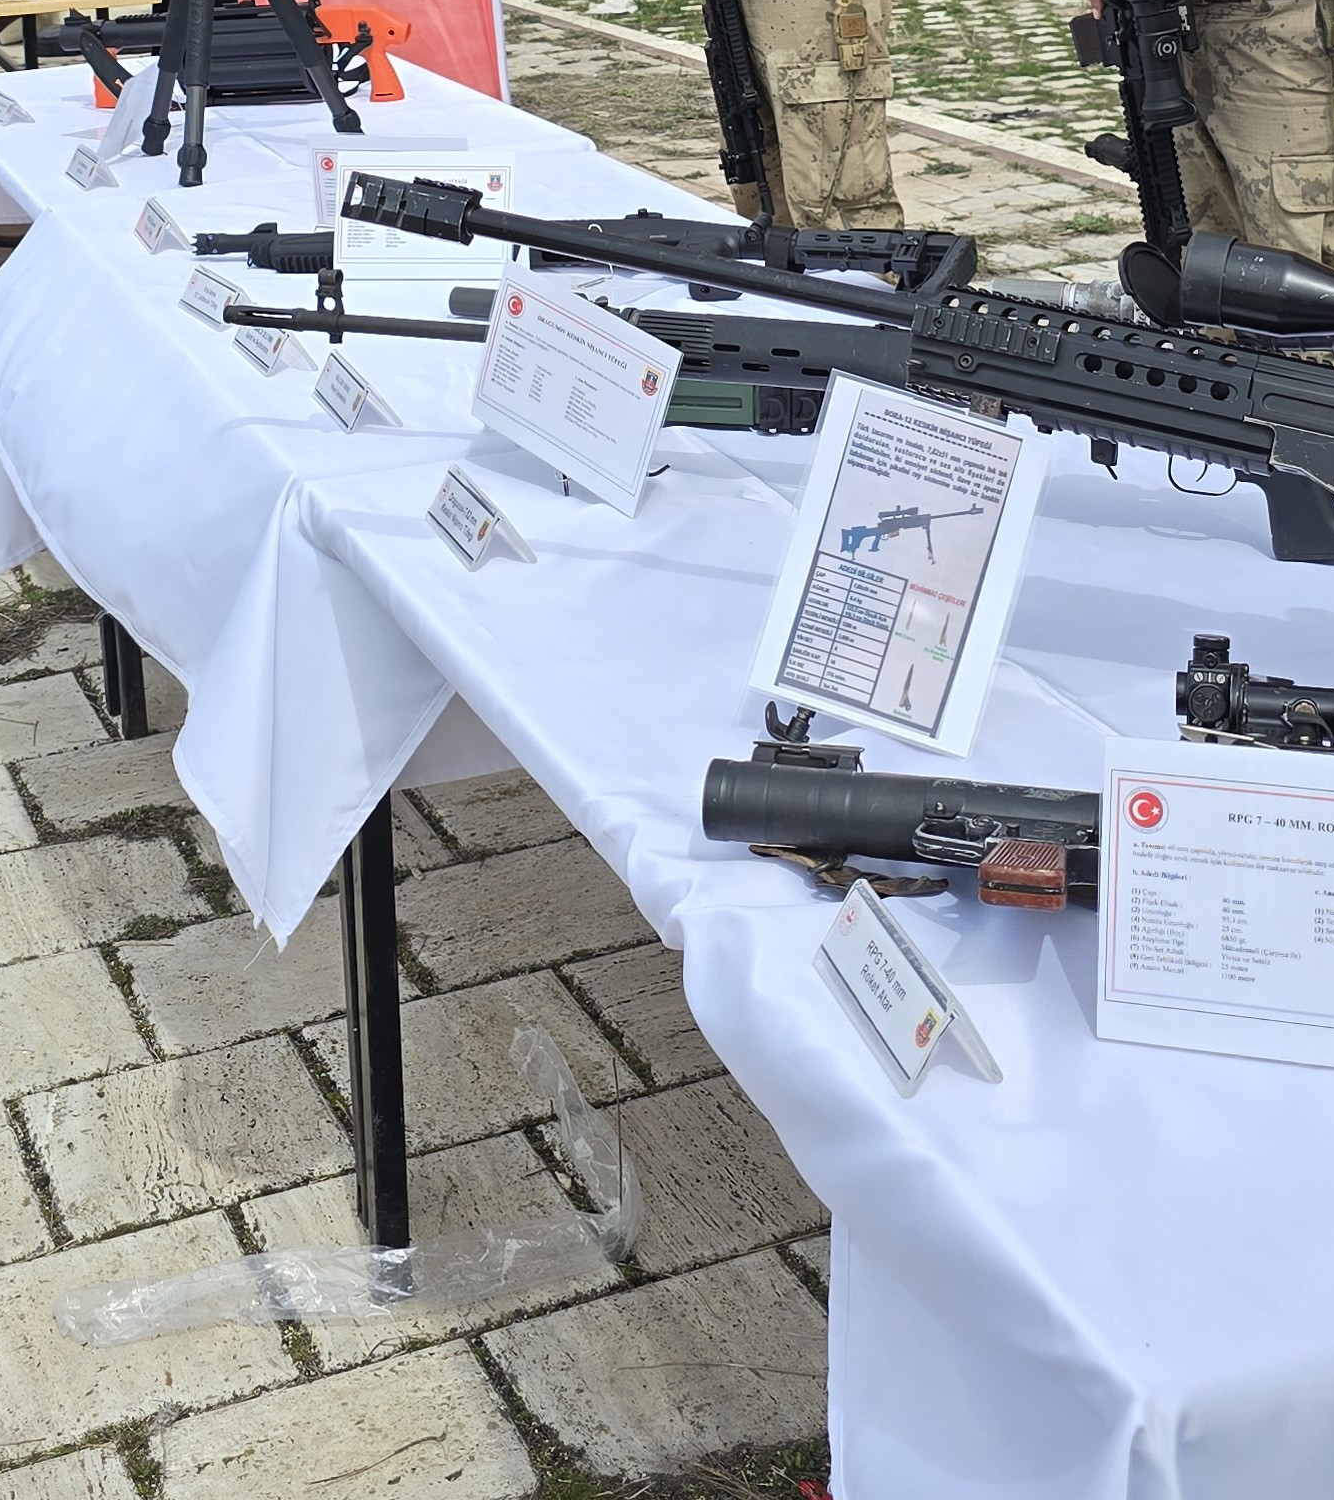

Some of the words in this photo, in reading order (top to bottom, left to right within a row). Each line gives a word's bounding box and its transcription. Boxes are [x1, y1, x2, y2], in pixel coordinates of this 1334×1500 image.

[856, 422, 869, 431] Türk
[967, 436, 991, 449] TÜFEĞİ
[838, 563, 856, 574] ADEDİ
[857, 569, 884, 583] BİLGİLER
[1227, 813, 1252, 824] RPG
[1256, 816, 1262, 825] 7
[1273, 818, 1285, 827] 40
[1289, 819, 1314, 830] MM.
[1154, 852, 1173, 861] doğru
[1210, 858, 1222, 866] için
[1314, 907, 1324, 915] (1)
[1131, 915, 1140, 923] (4)
[1130, 924, 1139, 932] (5)
[1129, 952, 1139, 960] (8)
[1129, 961, 1138, 969] (9)
[865, 940, 882, 965] RPG
[879, 959, 895, 983] 7-40
[891, 979, 906, 1001] mm
[1221, 972, 1236, 980] 1100
[860, 964, 881, 995] Roket
[877, 989, 893, 1014] Atar
